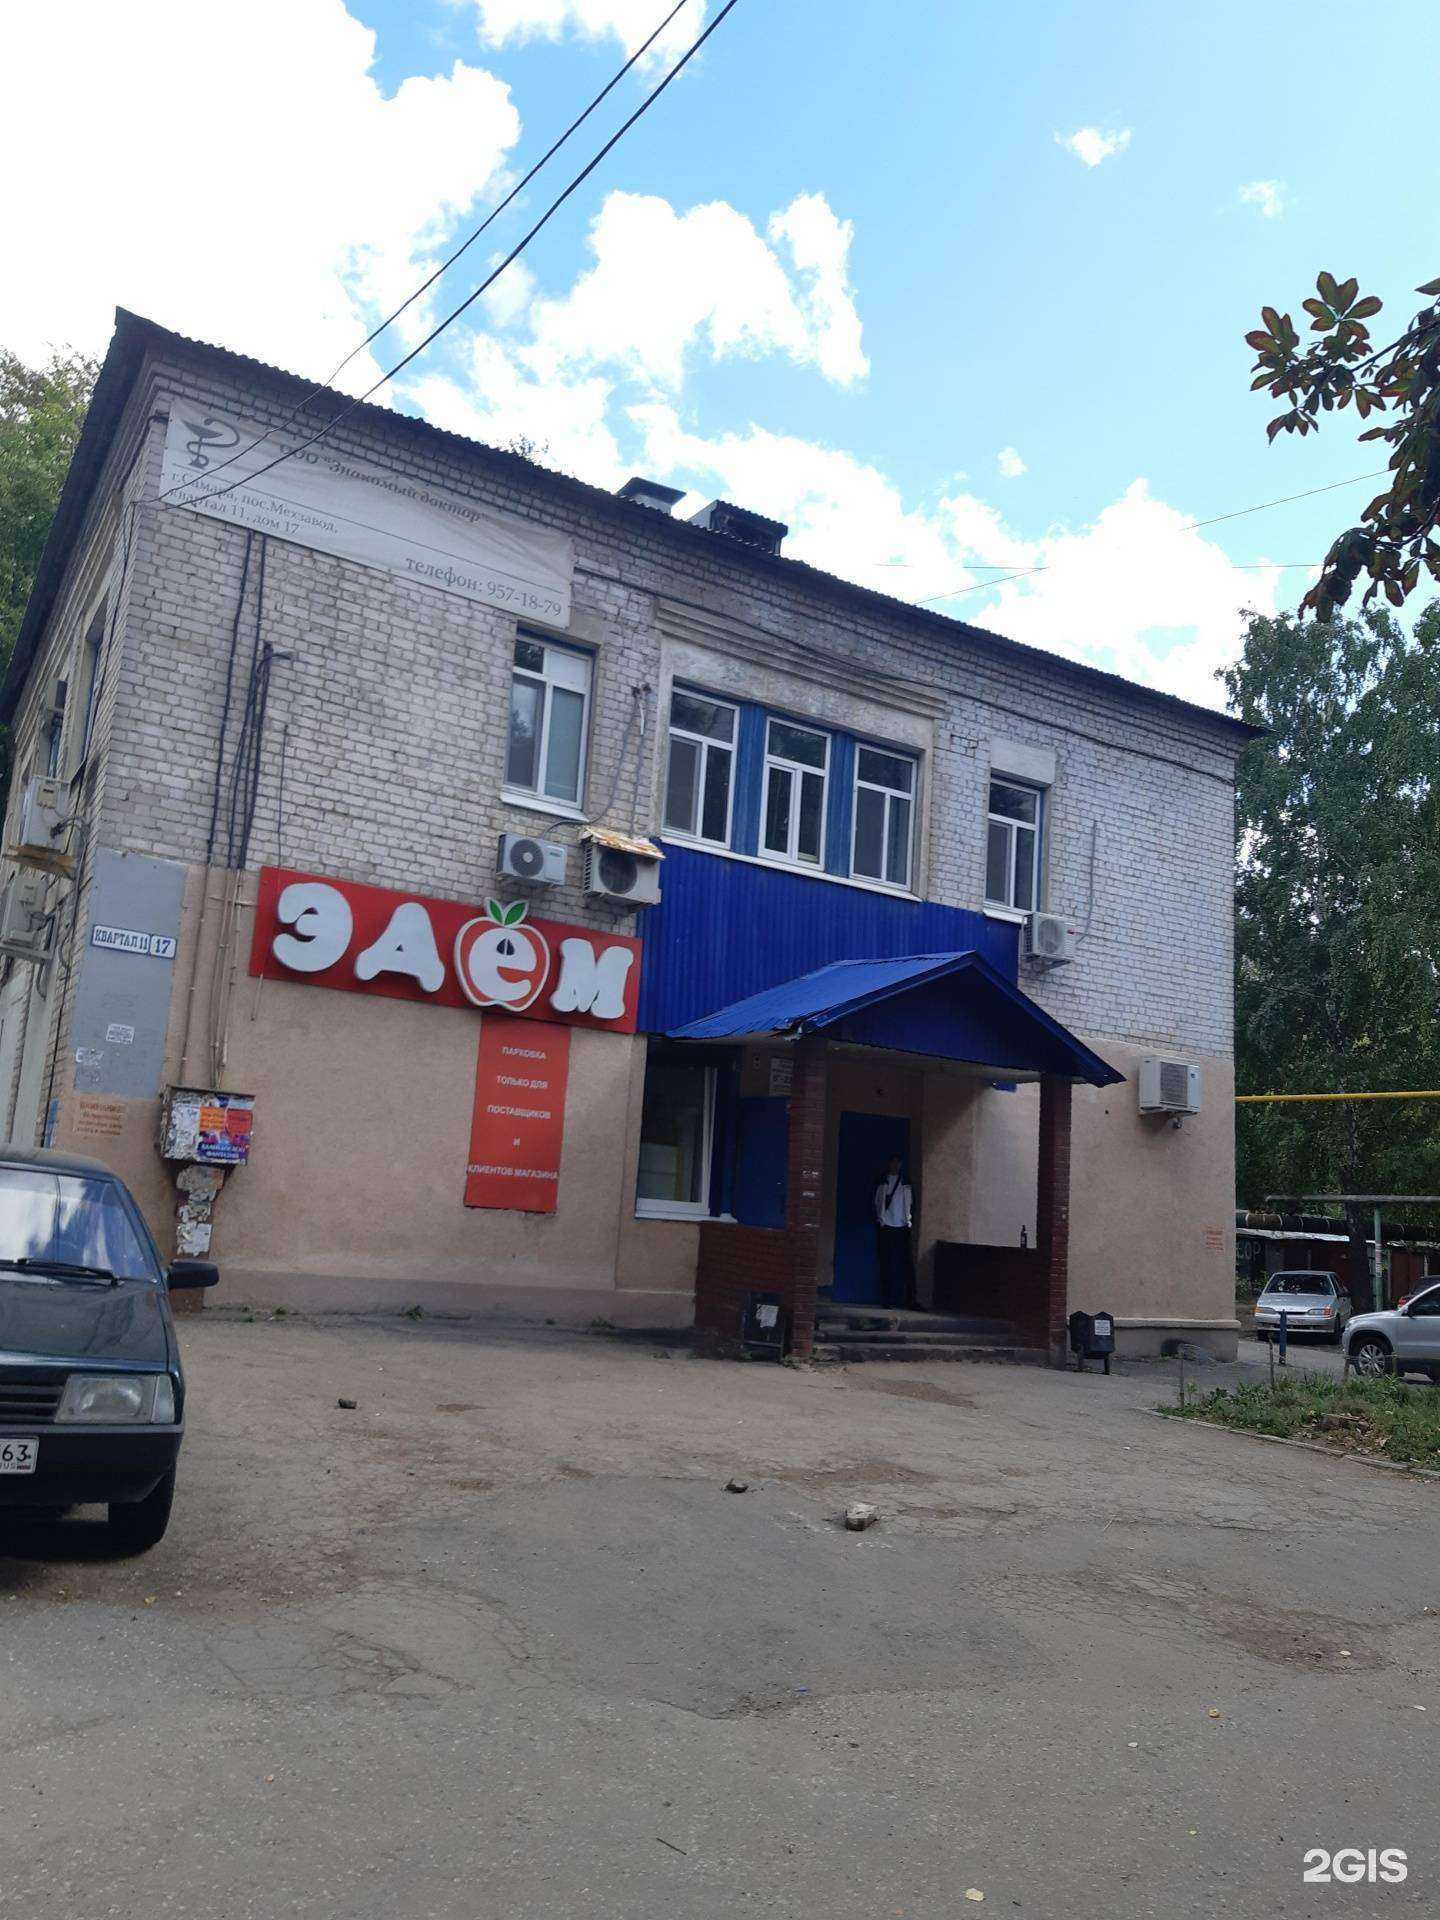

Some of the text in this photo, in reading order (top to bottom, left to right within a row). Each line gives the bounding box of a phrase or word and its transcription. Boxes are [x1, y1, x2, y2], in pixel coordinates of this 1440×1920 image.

[253, 514, 280, 529] дом
[284, 520, 300, 535] 17
[405, 557, 562, 616] телефон: 957-18-79
[94, 928, 148, 950] КВАРТАЛ 11
[155, 938, 171, 954] 17
[502, 1046, 547, 1060] ПАРКОВКА
[496, 1074, 548, 1089] ТОЛЬКО ДЛЯ
[487, 1104, 551, 1120] ПОСТАВЩИКОВ
[468, 1163, 559, 1180] КЛИЕНТОВ МАГАЗИНА
[2, 1444, 28, 1461] 63
